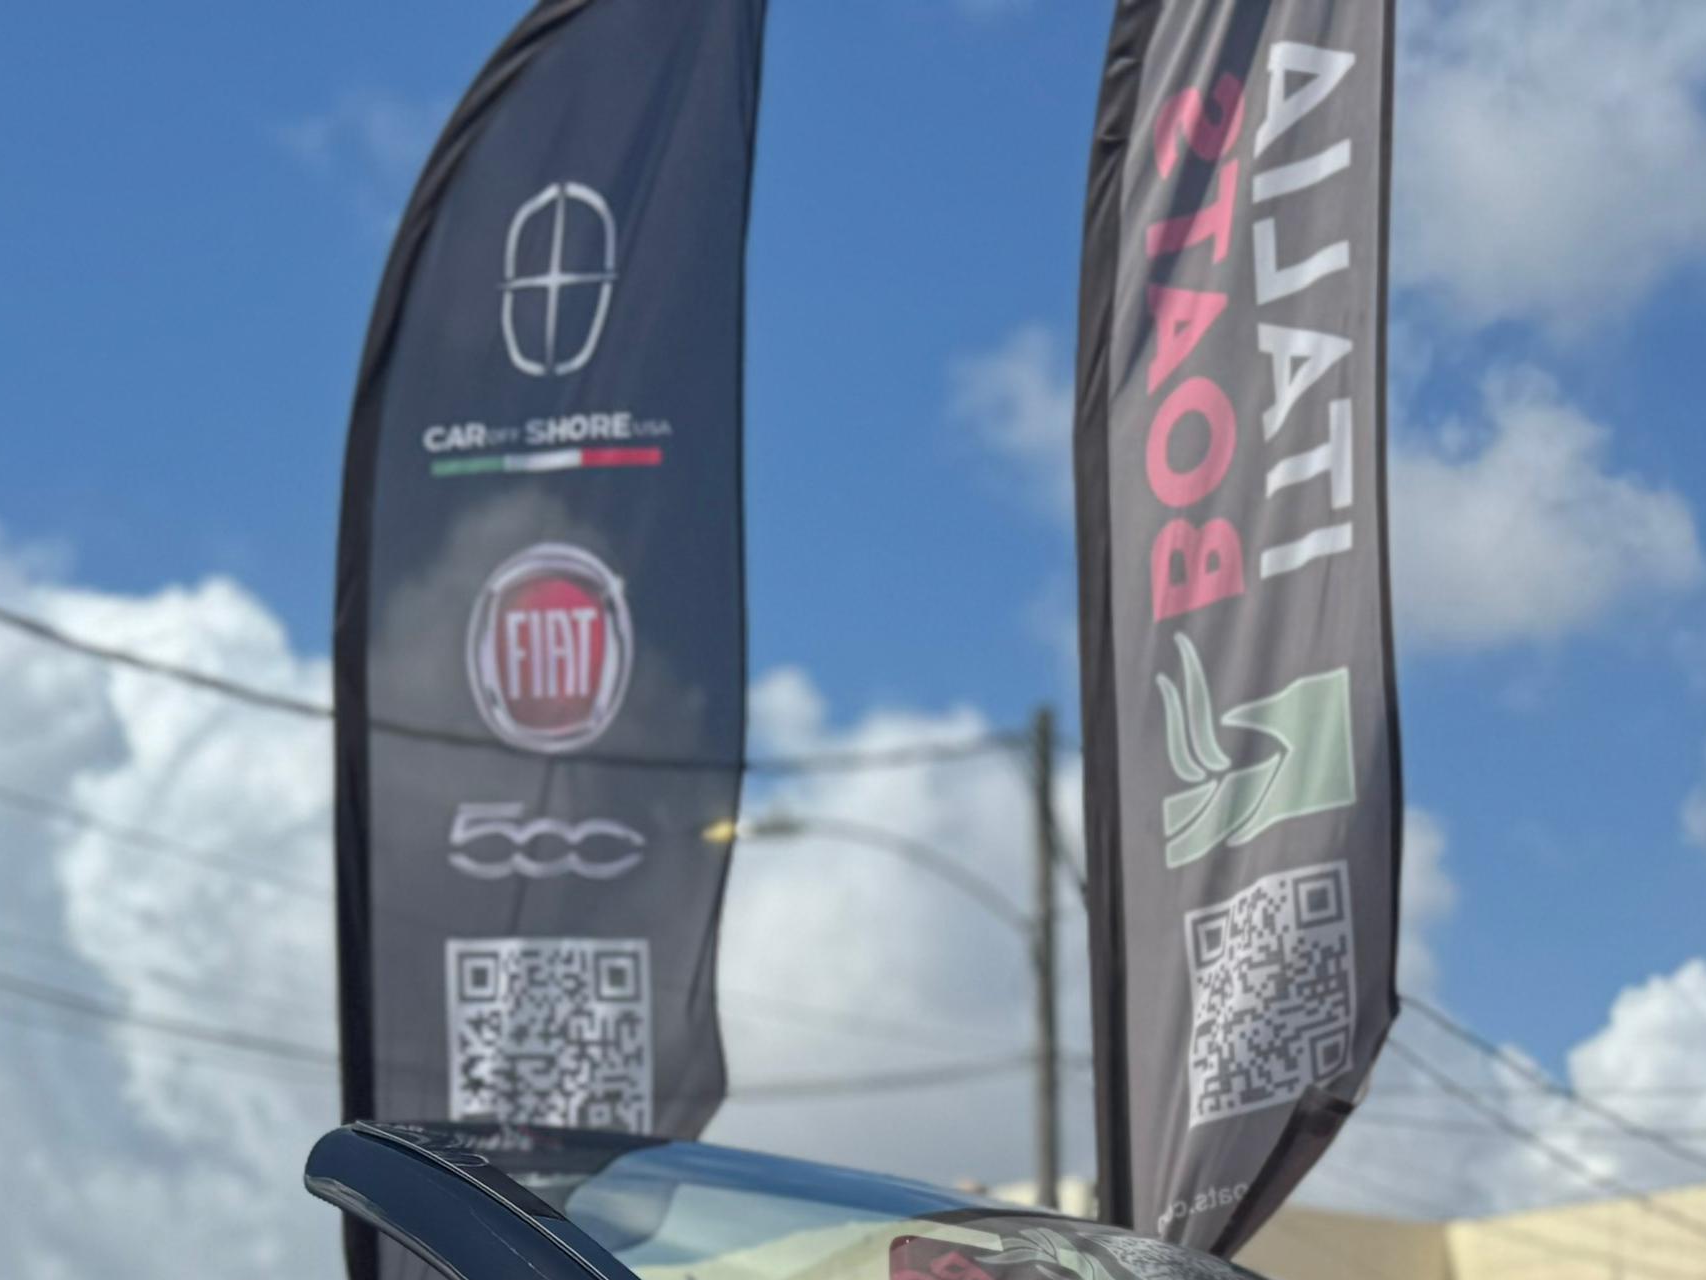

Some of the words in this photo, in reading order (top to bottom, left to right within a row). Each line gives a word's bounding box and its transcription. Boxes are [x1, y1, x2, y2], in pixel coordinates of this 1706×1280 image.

[422, 421, 487, 452] CAR
[525, 411, 631, 445] SHORE
[505, 607, 597, 699] FIAT
[447, 802, 646, 880] 500
